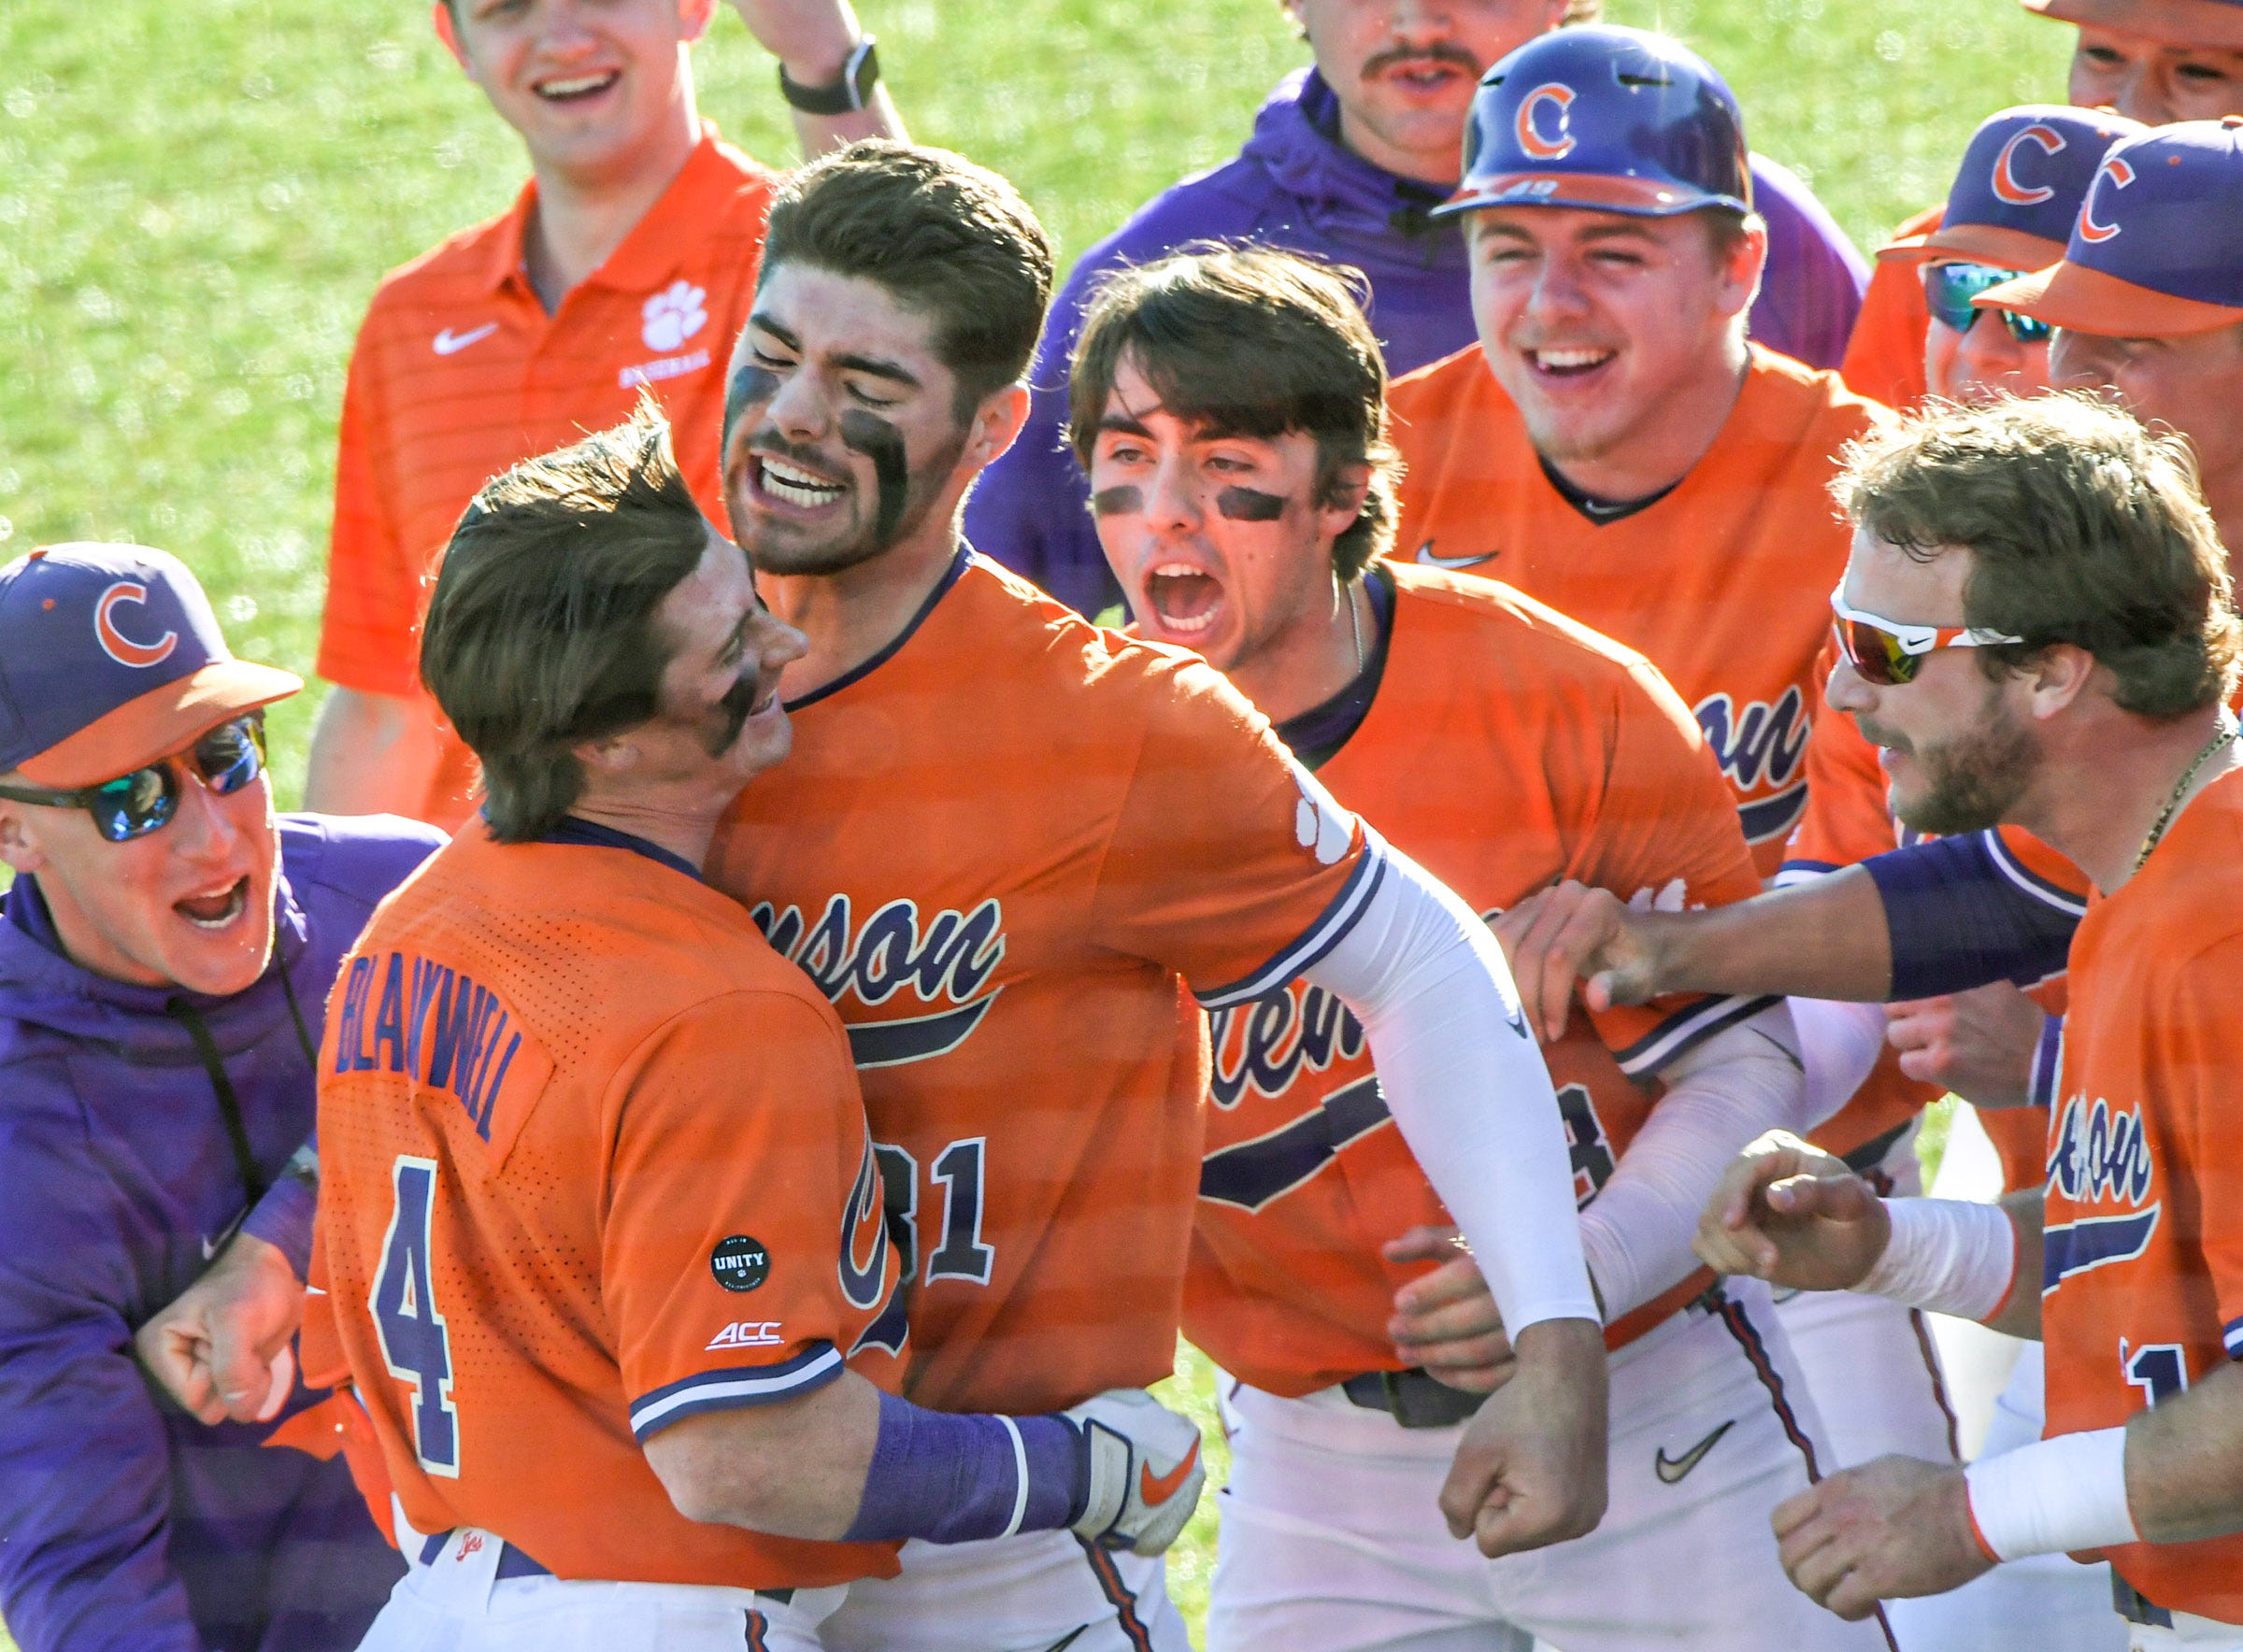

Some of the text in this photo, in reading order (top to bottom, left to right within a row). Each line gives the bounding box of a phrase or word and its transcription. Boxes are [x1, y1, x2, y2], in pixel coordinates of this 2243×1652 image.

[1515, 82, 1578, 160] C
[1992, 124, 2067, 206] C
[2079, 157, 2136, 243] C
[93, 580, 179, 668] C
[714, 1252, 764, 1271] UNITY
[367, 1154, 460, 1479] 4
[707, 1321, 783, 1348] ACC
